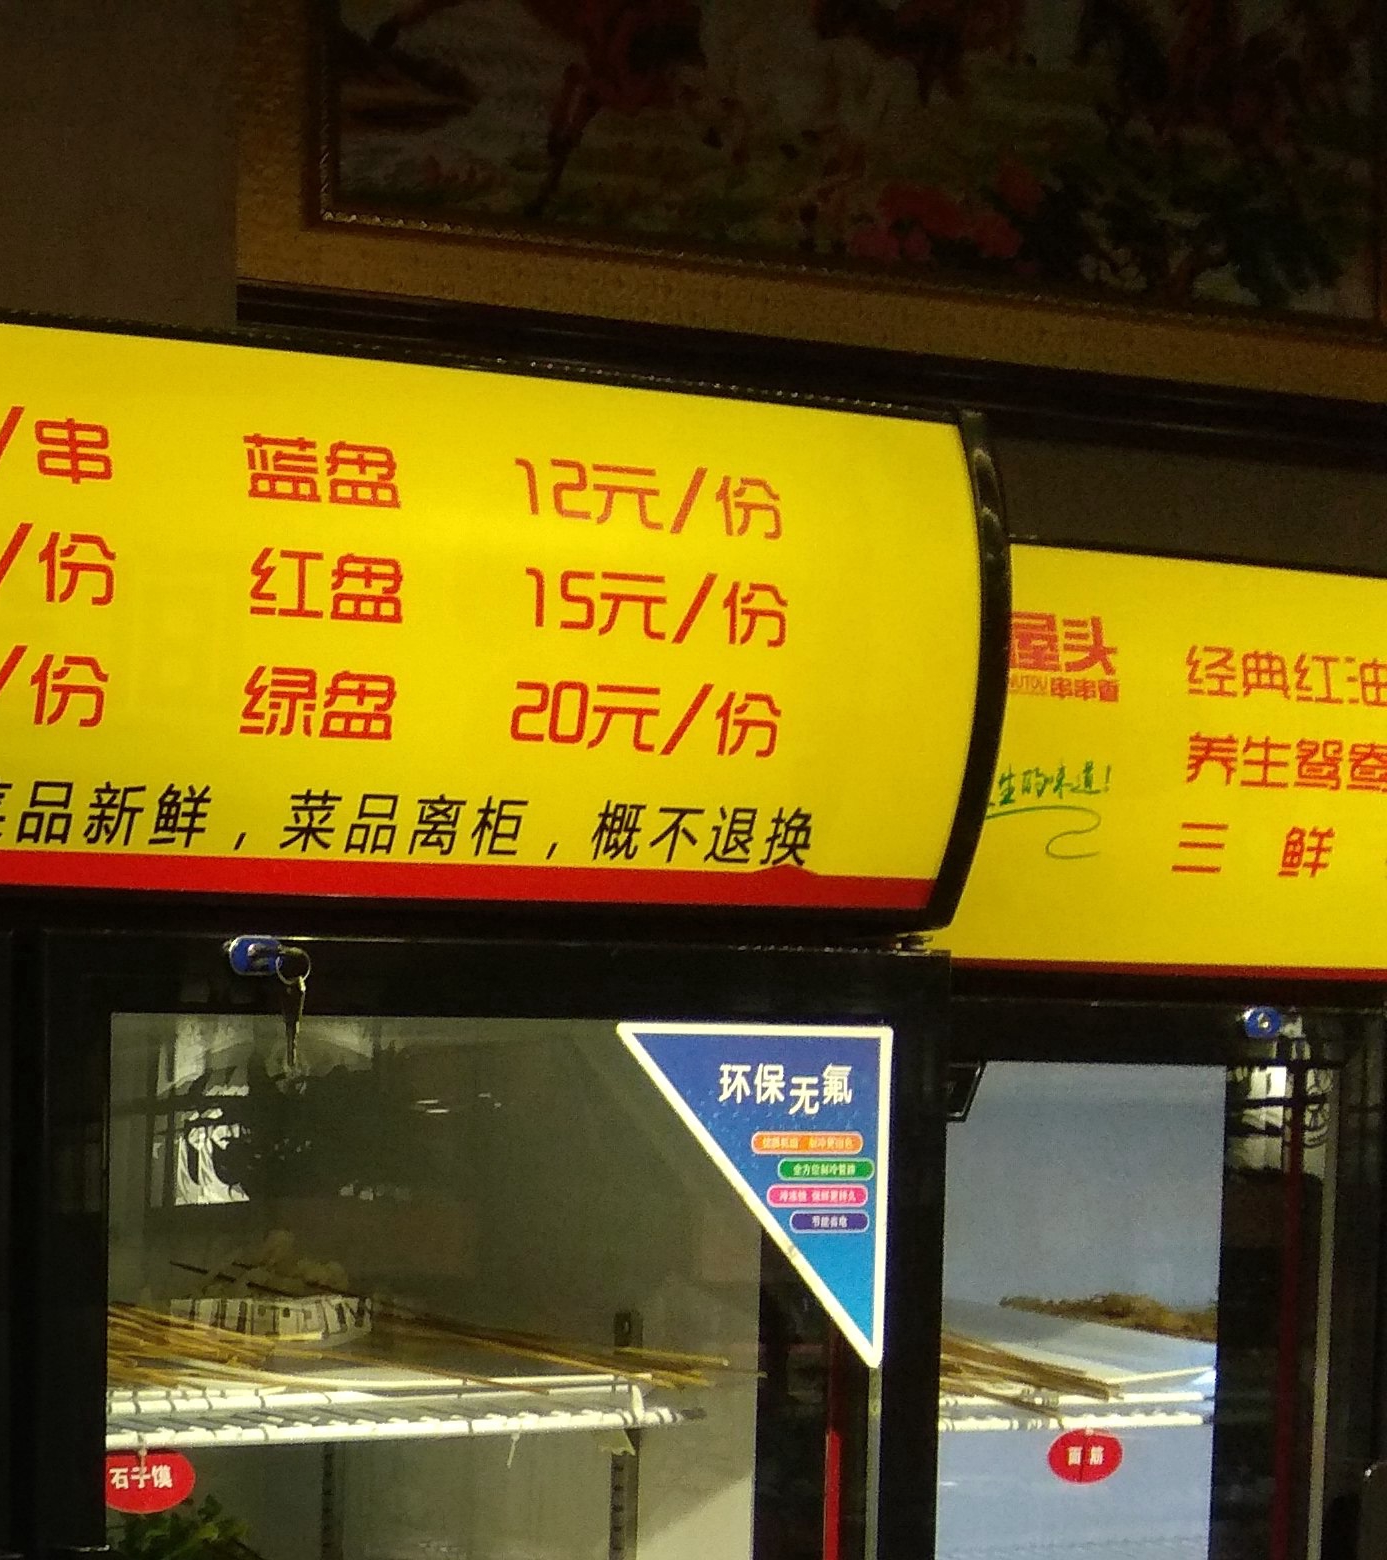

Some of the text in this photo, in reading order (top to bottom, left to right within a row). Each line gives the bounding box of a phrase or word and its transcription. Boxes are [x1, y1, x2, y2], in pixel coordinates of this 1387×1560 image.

[243, 432, 402, 510] 蓝盘
[514, 455, 785, 541] 12元/份
[248, 546, 404, 625] 红盘
[524, 565, 790, 649] 15元/份
[1009, 610, 1119, 676] 屋头
[1185, 644, 1387, 707] 经典红油
[238, 664, 398, 741] 绿盘
[509, 679, 784, 760] 20元/份
[989, 759, 1112, 807] 生的味道!
[718, 1062, 853, 1116] 环保无氟
